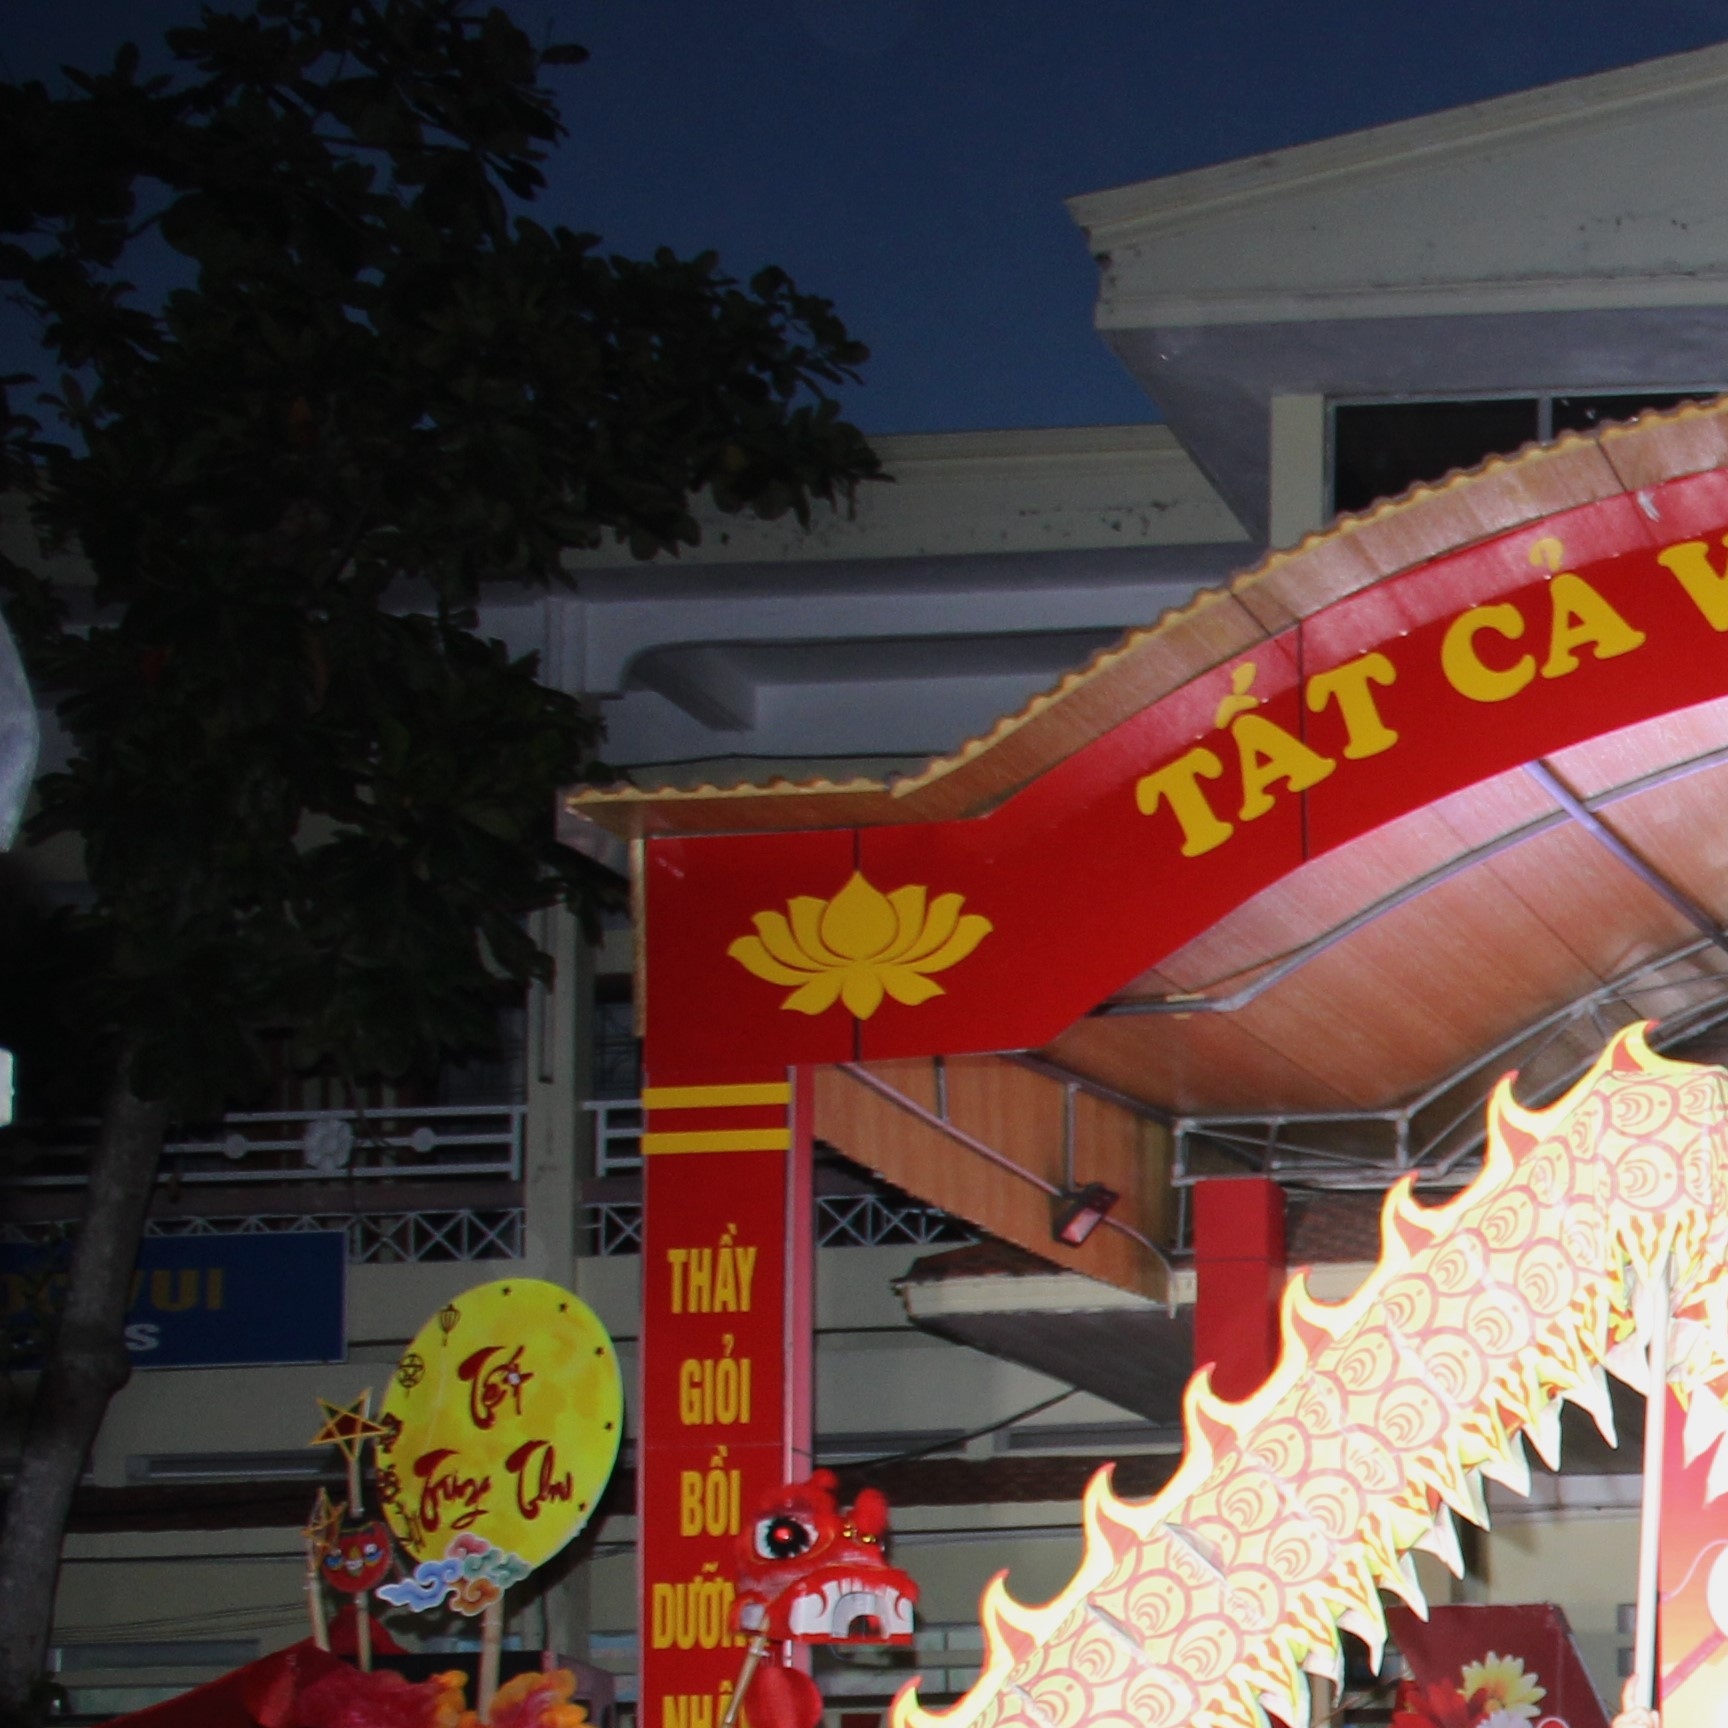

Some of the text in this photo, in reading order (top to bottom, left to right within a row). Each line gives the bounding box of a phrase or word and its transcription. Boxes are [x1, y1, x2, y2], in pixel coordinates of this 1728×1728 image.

[1136, 653, 1398, 857] TẤT
[1441, 537, 1645, 702] CẢ
[666, 1222, 758, 1314] THẦY
[679, 1333, 752, 1426] GIỎI
[506, 1440, 572, 1519] Thu
[679, 1445, 741, 1537] BỒI
